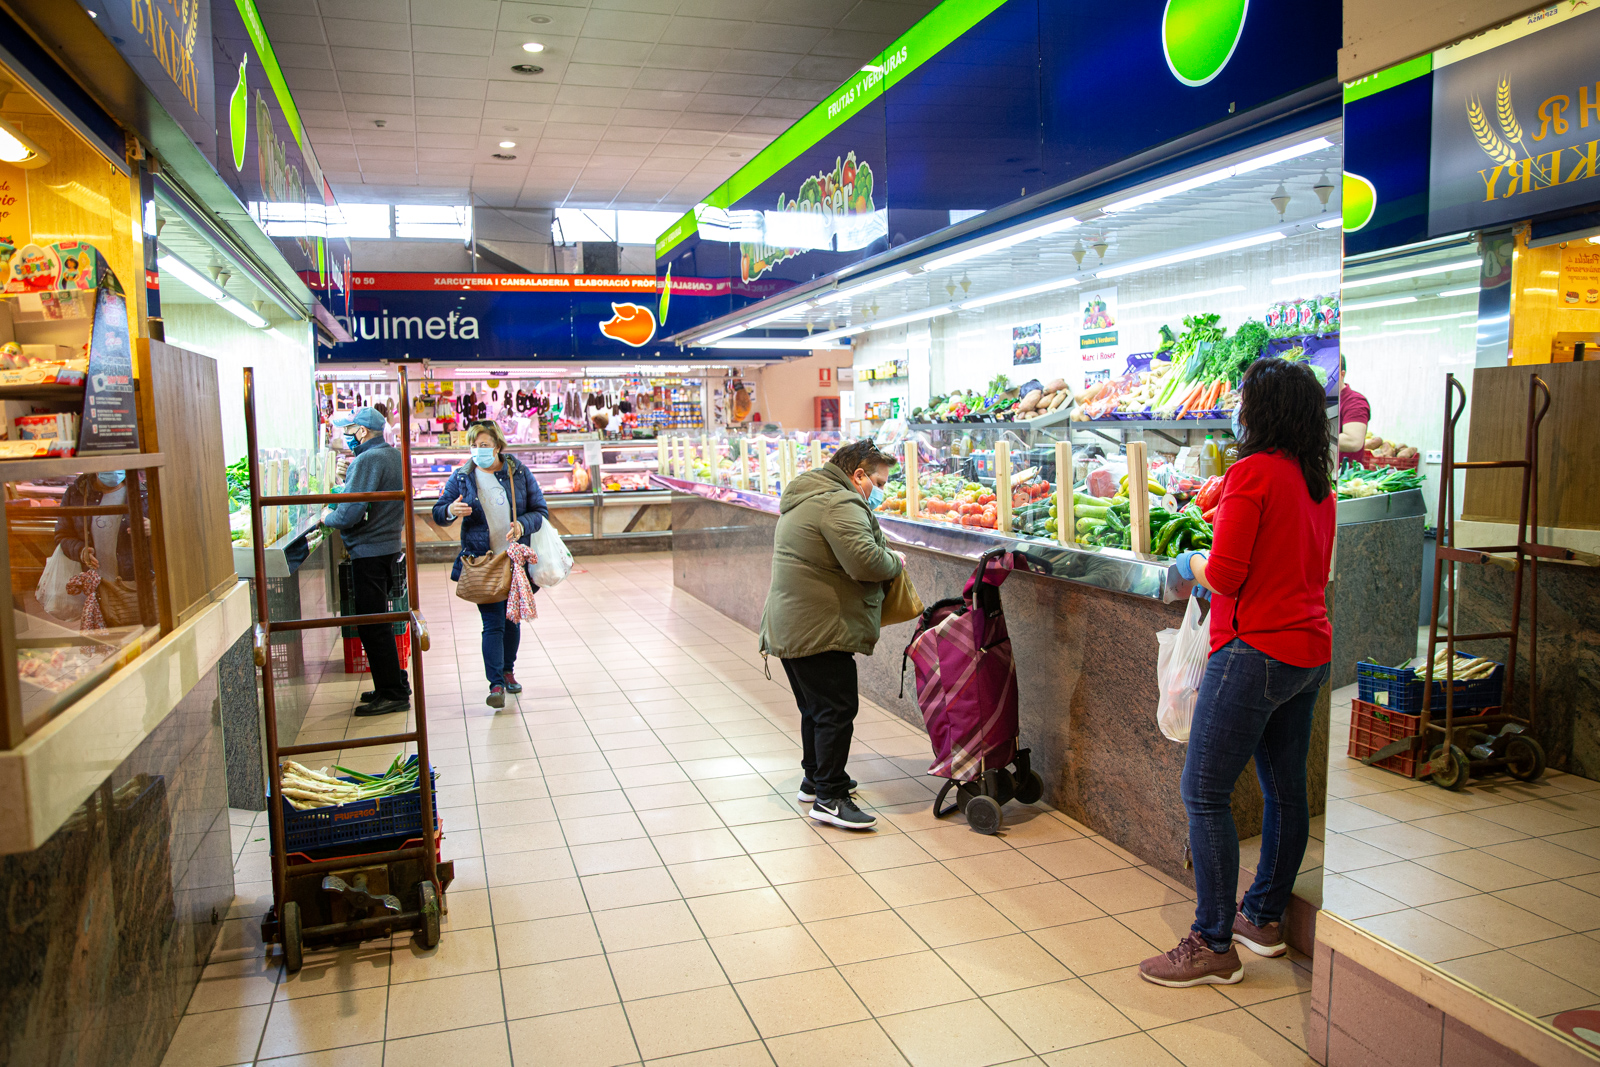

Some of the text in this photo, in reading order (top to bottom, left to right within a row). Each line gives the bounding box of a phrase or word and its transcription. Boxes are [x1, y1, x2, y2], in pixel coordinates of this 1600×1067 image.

[827, 45, 908, 120] FRUTAS Y VERDURAS
[14, 258, 55, 275] SORPRESA
[364, 277, 375, 285] 50
[433, 277, 493, 286] XARCUTERIA
[495, 278, 499, 286] I
[500, 278, 570, 287] CANSALADERIA
[574, 278, 630, 287] ELABORACIÓ
[353, 309, 480, 342] uimeta
[334, 808, 376, 822] FRUFERGO
